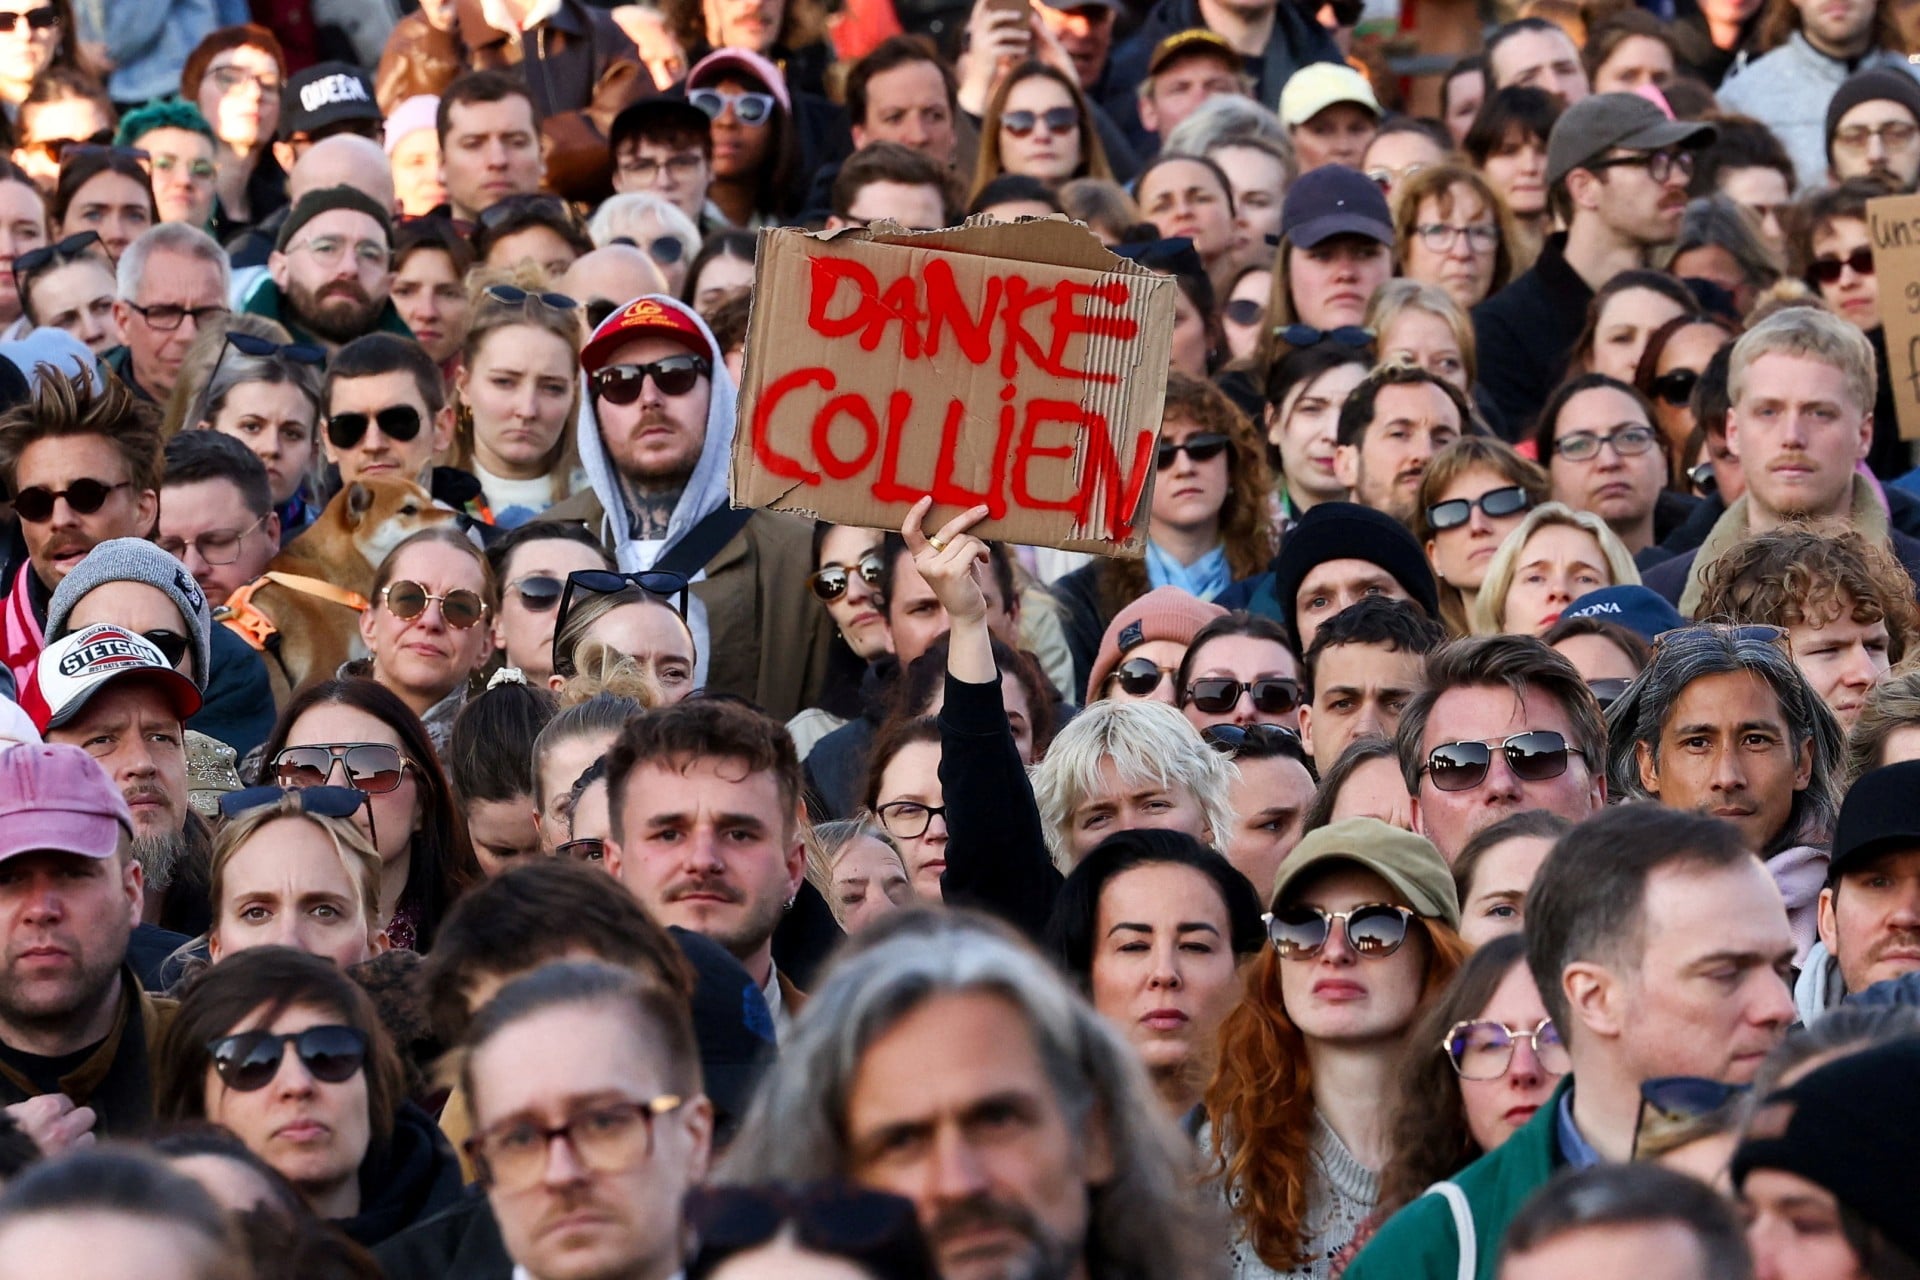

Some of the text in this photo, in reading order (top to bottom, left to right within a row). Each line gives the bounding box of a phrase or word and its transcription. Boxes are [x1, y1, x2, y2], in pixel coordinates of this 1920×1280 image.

[807, 255, 1138, 385] DANKE
[77, 626, 106, 645] AMERICAN
[62, 640, 159, 675] STETSON
